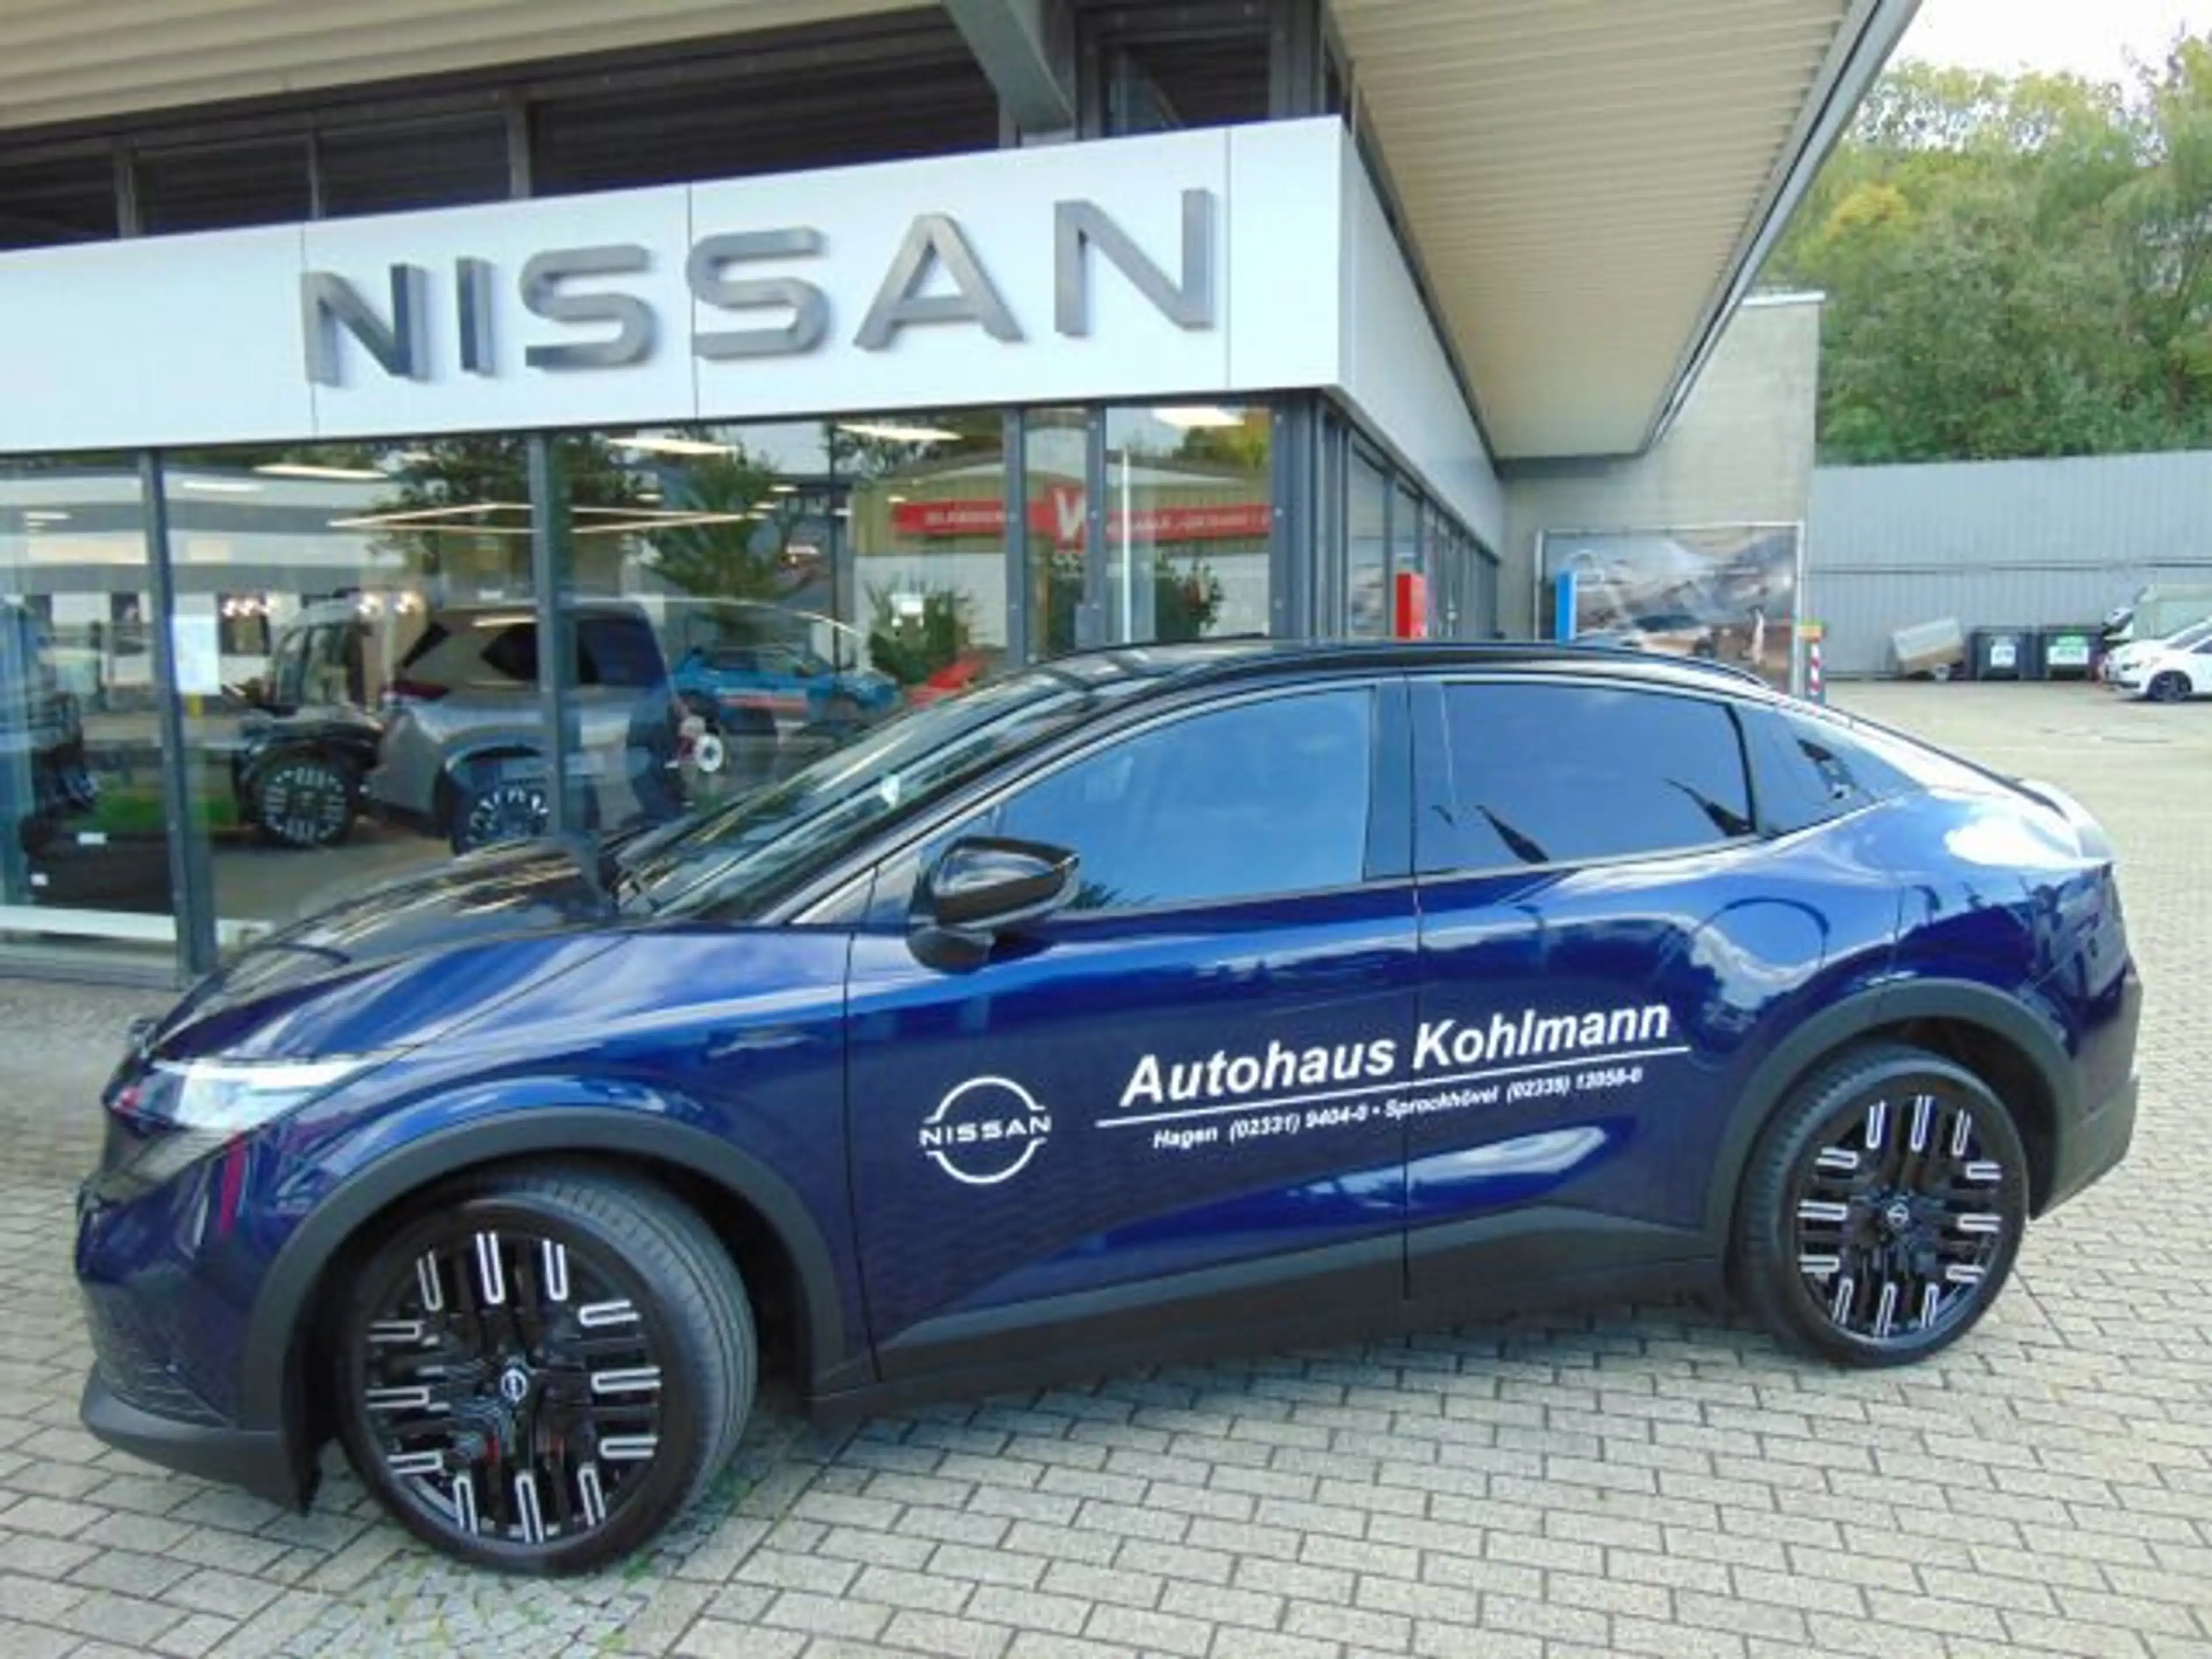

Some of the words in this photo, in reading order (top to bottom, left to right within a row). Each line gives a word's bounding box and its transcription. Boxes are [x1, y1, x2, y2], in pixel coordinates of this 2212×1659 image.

[302, 185, 1215, 386] NISSAN
[1118, 1039, 1397, 1107] Autohaus
[1412, 1003, 1671, 1070] Kohlmann
[920, 1116, 1052, 1146] NISSAN
[1153, 1127, 1218, 1149] Hagen
